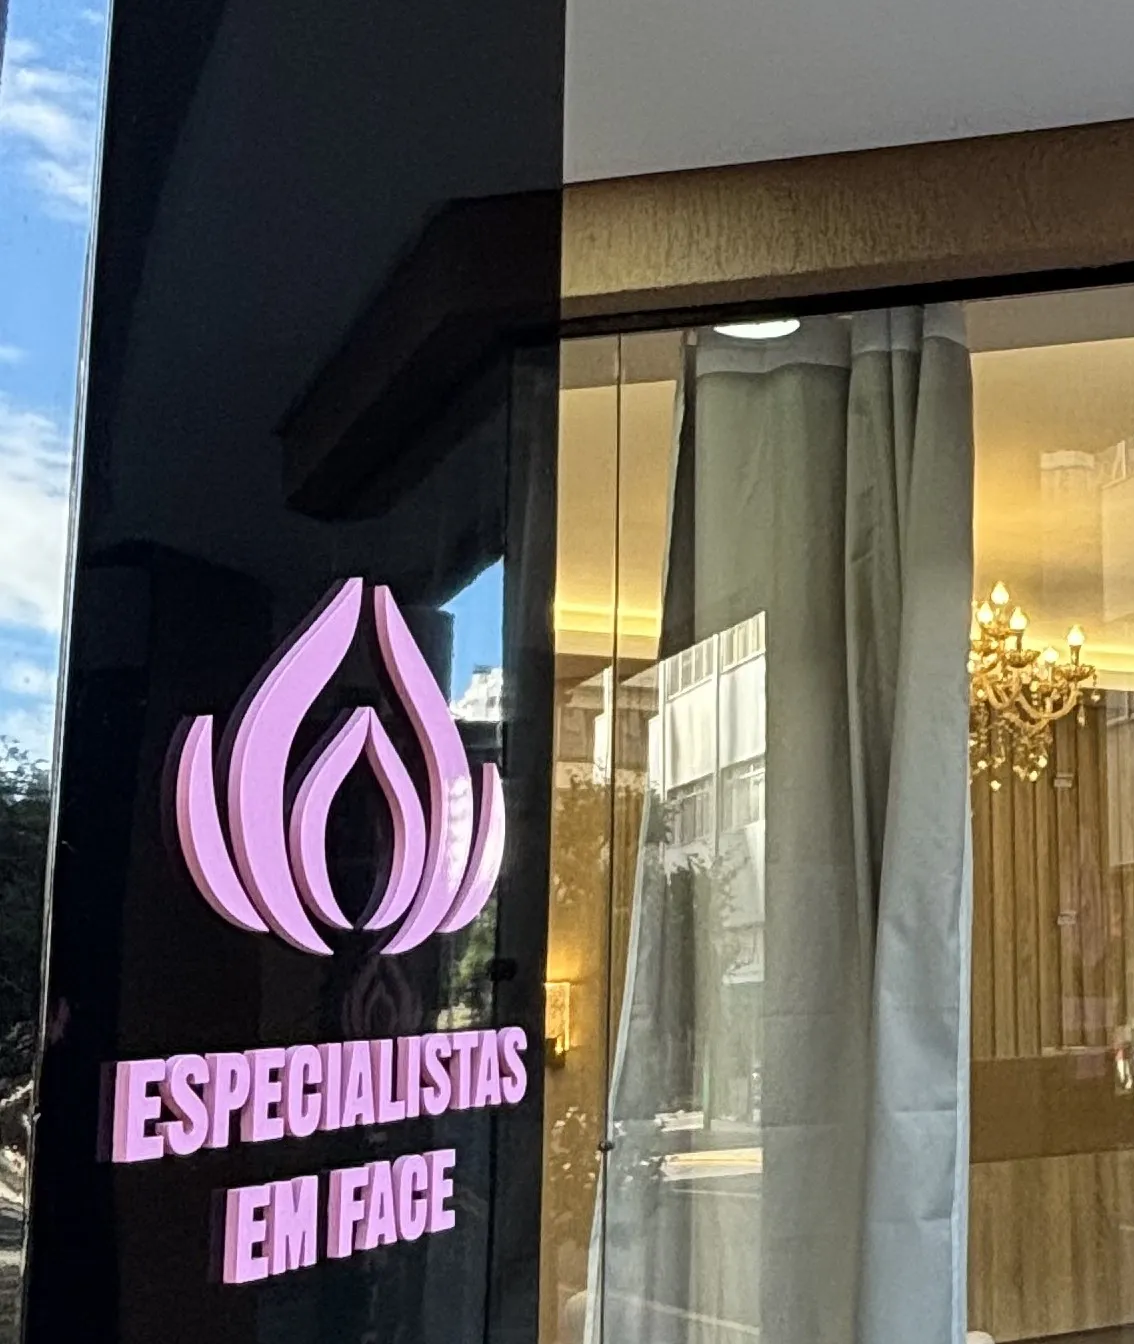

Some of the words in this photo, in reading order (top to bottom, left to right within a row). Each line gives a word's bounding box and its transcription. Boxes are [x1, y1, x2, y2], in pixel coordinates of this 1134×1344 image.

[112, 1026, 529, 1163] ESPECIALISTAS
[224, 1175, 319, 1284] EM
[327, 1149, 456, 1260] FACE
